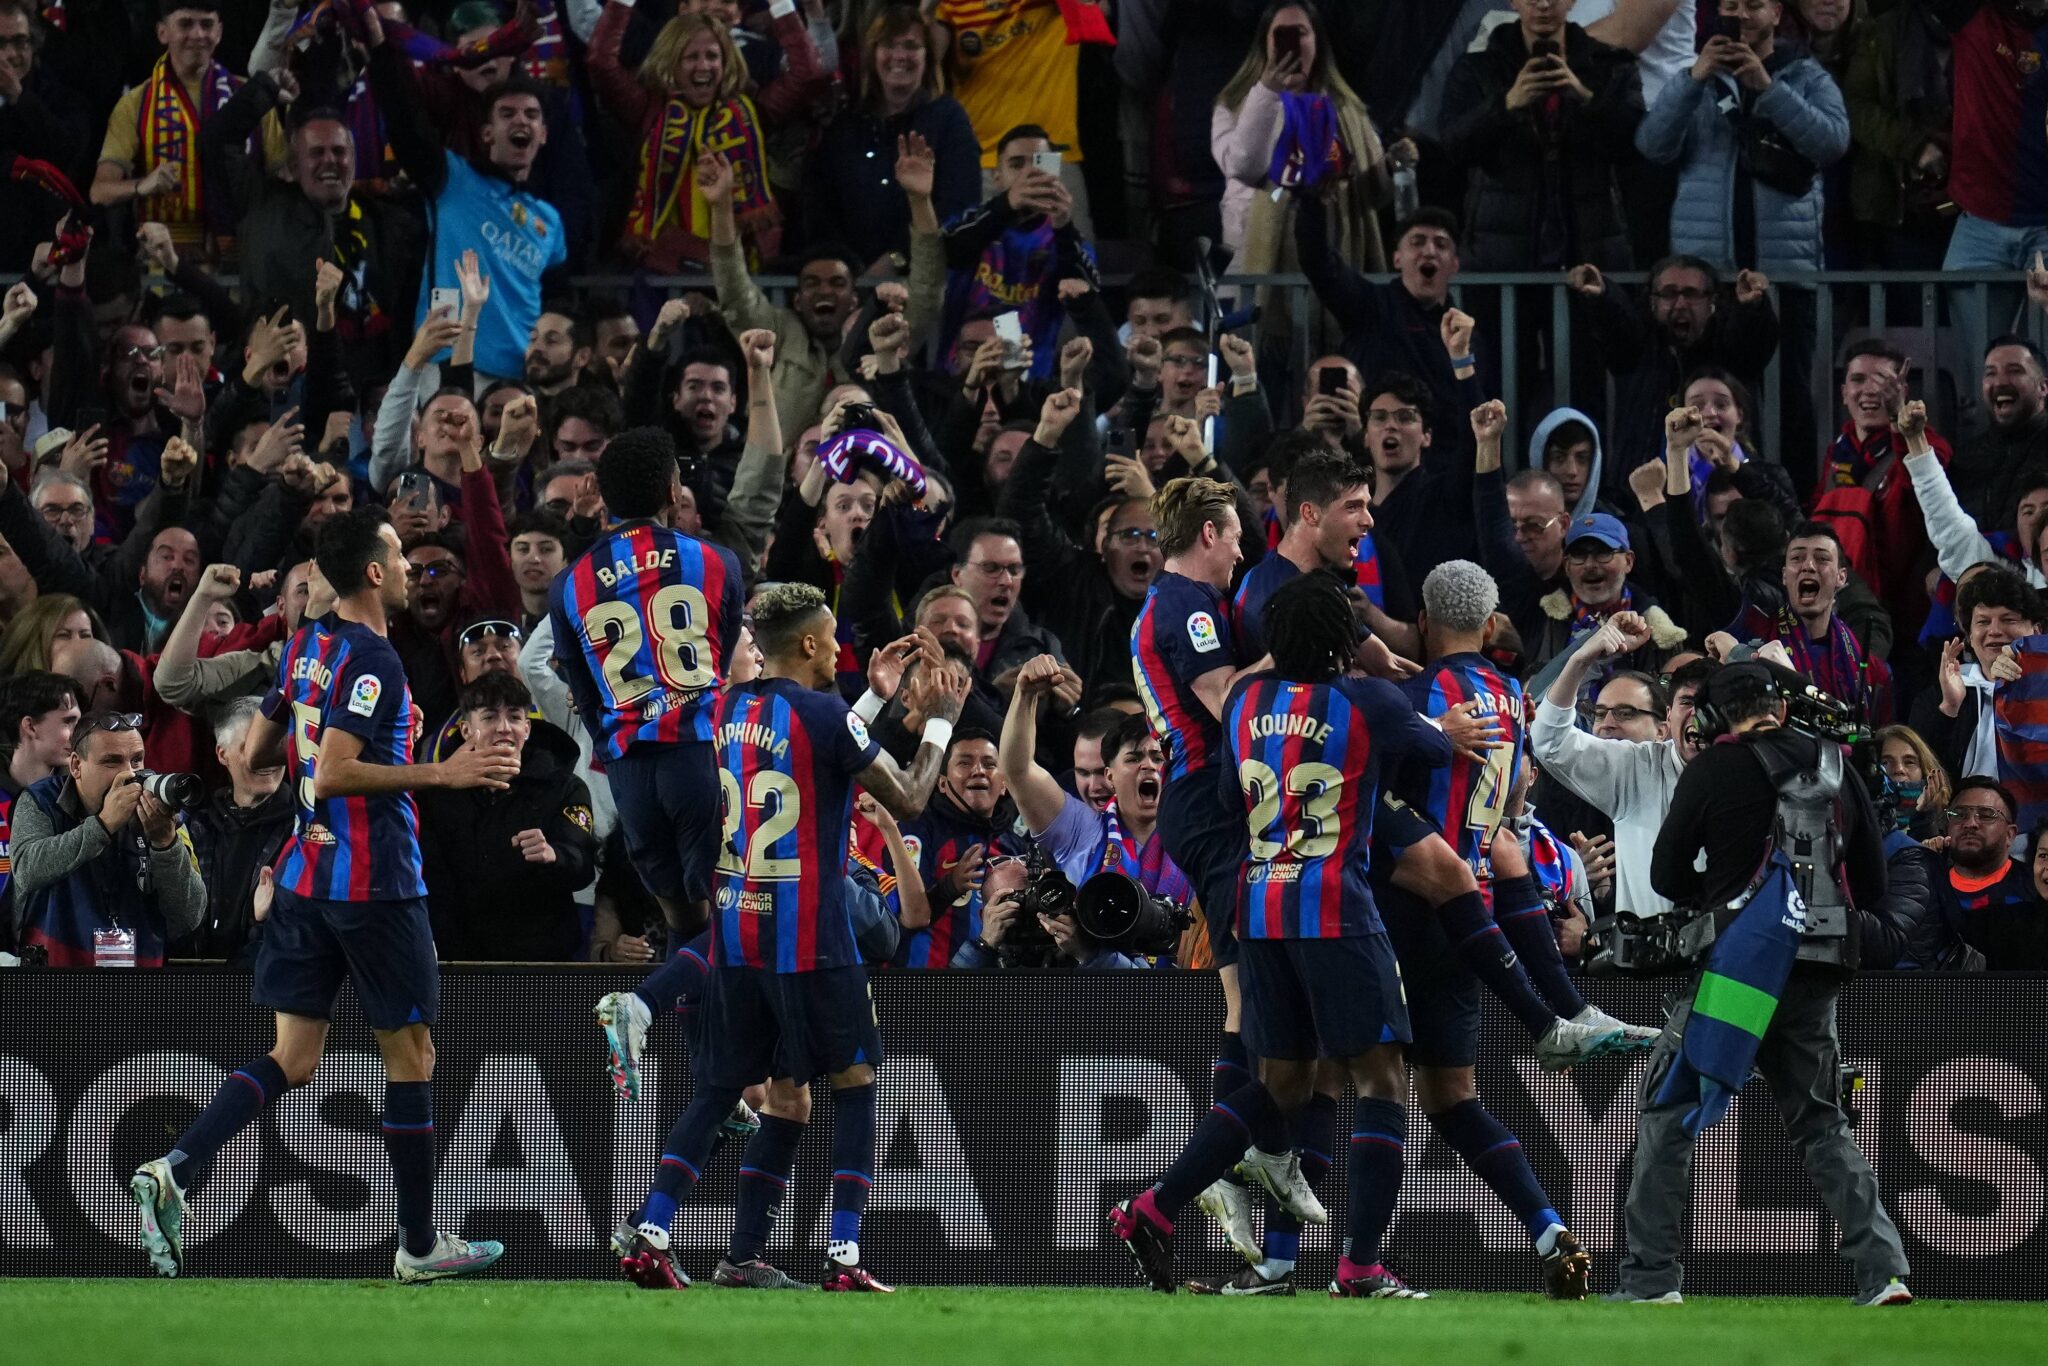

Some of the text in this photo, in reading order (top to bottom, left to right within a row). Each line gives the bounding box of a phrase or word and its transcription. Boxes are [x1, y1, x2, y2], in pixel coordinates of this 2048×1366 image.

[596, 549, 676, 588] BALDE
[583, 584, 716, 709] 28
[1196, 638, 1217, 648] LaLiga
[352, 700, 372, 712] LaLiga
[1248, 714, 1334, 745] KOUNDE
[291, 700, 322, 812] 5
[1466, 741, 1515, 848] 4
[1238, 758, 1345, 862] 23
[1266, 871, 1301, 880] ACNUR
[1268, 863, 1303, 872] UNHCR
[735, 901, 773, 911] ACNUR
[738, 890, 773, 902] UNHCR
